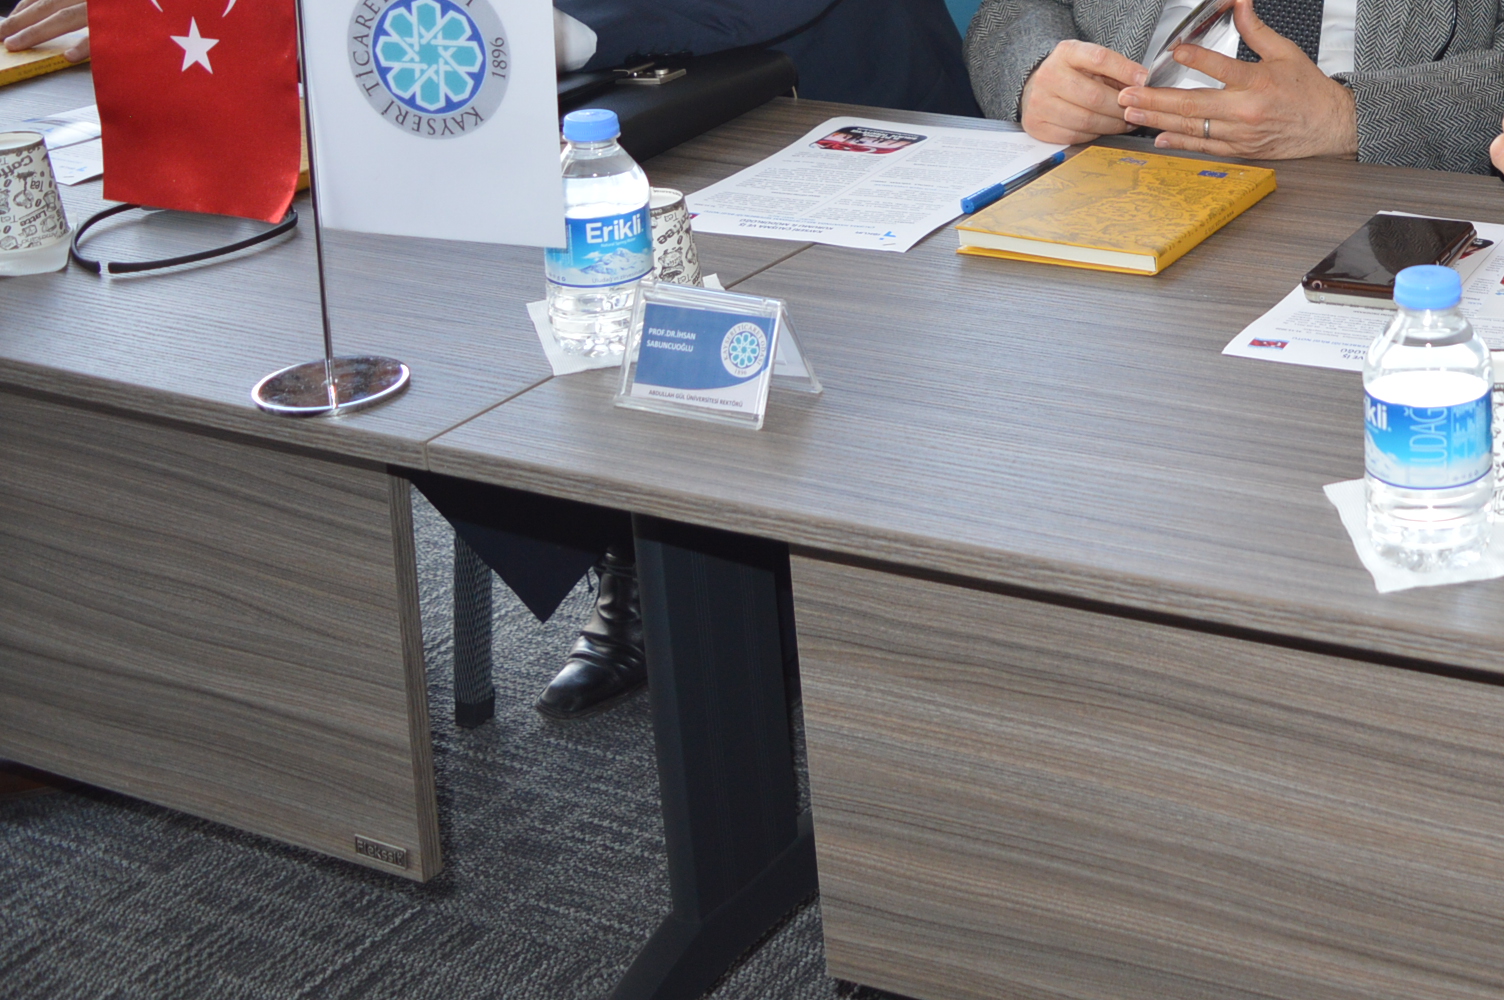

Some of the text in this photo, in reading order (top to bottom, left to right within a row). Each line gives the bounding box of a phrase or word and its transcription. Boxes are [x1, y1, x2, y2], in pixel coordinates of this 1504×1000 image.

[489, 36, 508, 80] 1896
[380, 99, 485, 136] KAYSERİ
[585, 213, 641, 244] Erikli
[646, 340, 694, 352] SABUNCUOĞLU
[648, 389, 675, 398] ABDULLAH
[675, 392, 685, 400] GÜL
[686, 394, 719, 404] ÜNİVERSİTESİ
